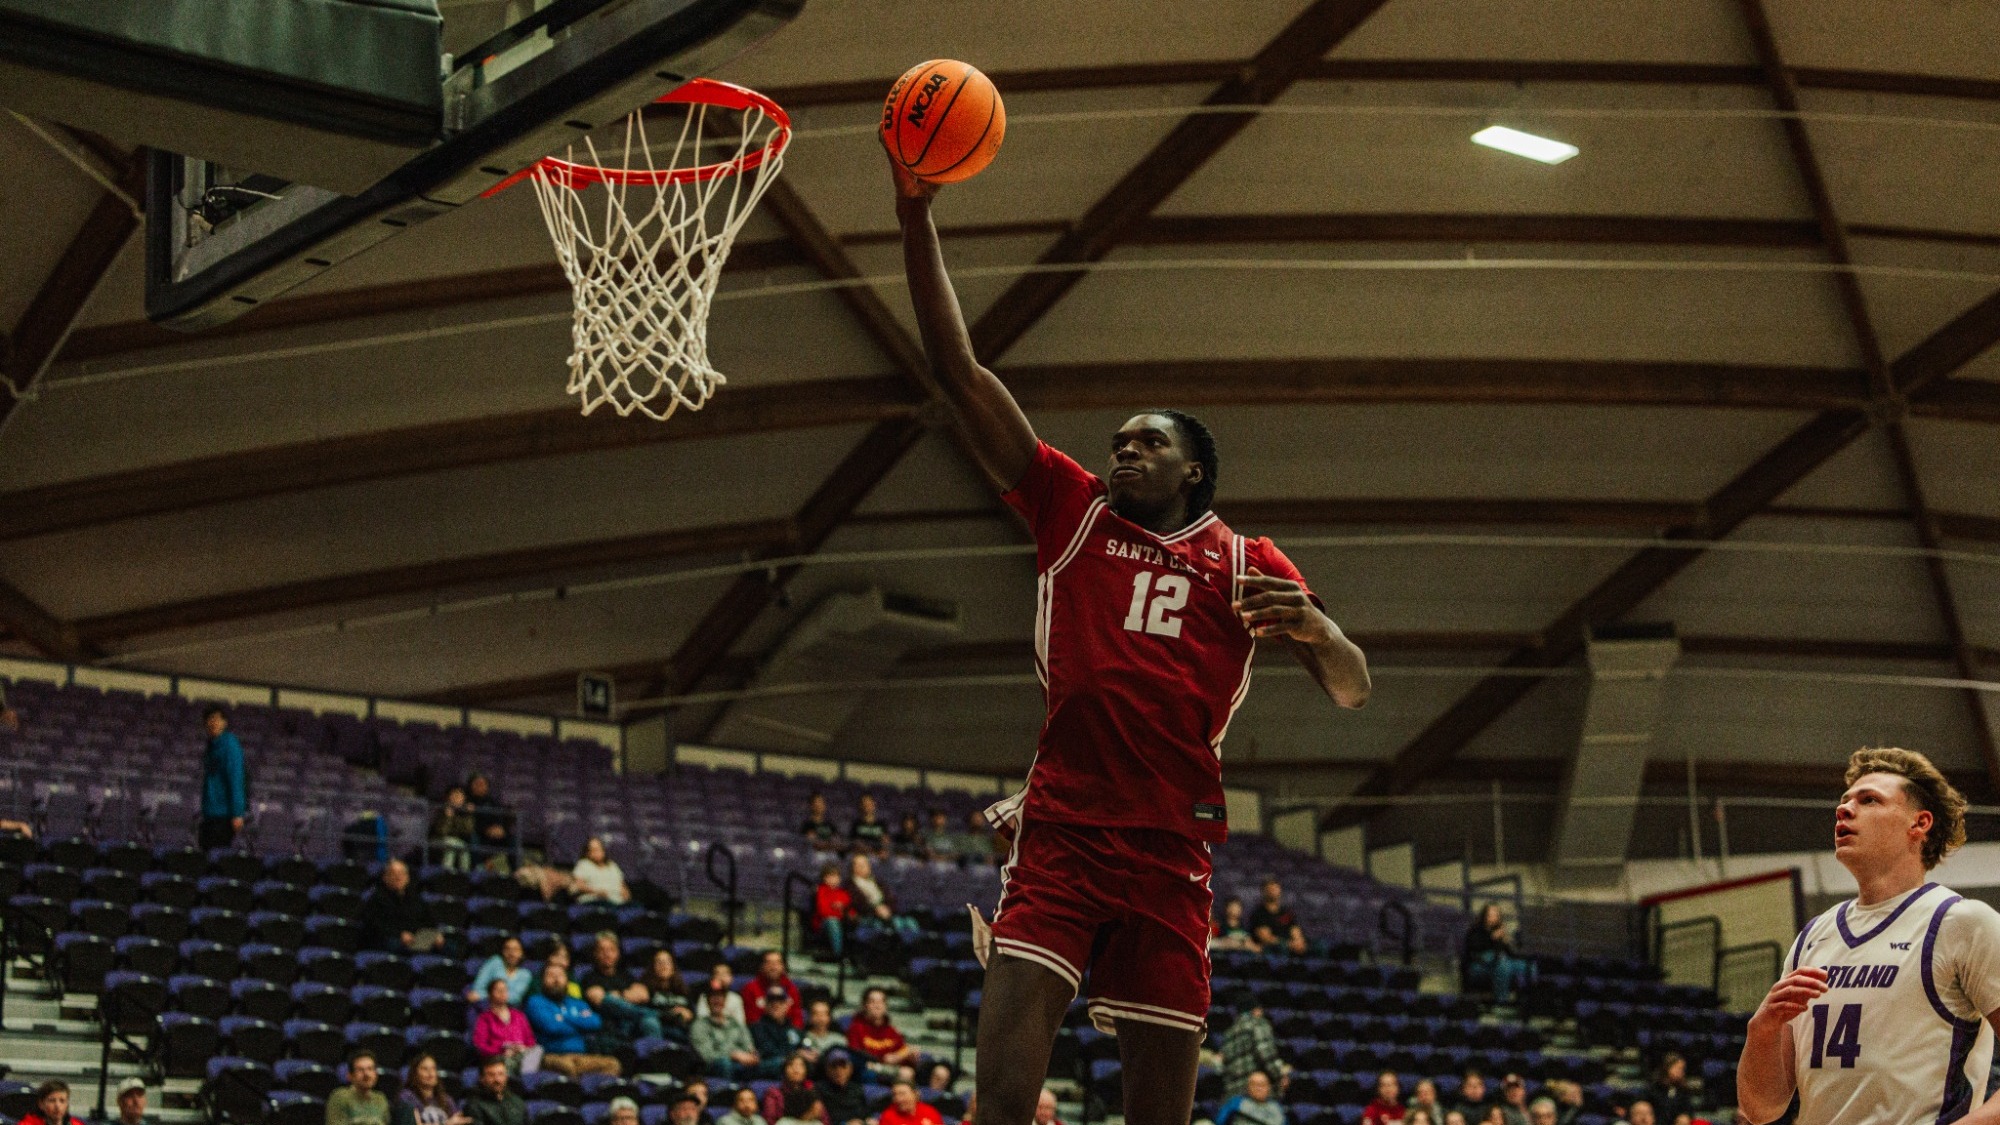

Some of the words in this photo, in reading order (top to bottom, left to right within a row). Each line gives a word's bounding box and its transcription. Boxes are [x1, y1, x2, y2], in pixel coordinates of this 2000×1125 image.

[908, 73, 948, 128] NCAA
[1105, 539, 1163, 566] SANTA
[1123, 571, 1191, 639] 12
[1820, 965, 1900, 988] RTLAND
[1810, 1004, 1863, 1069] 14
